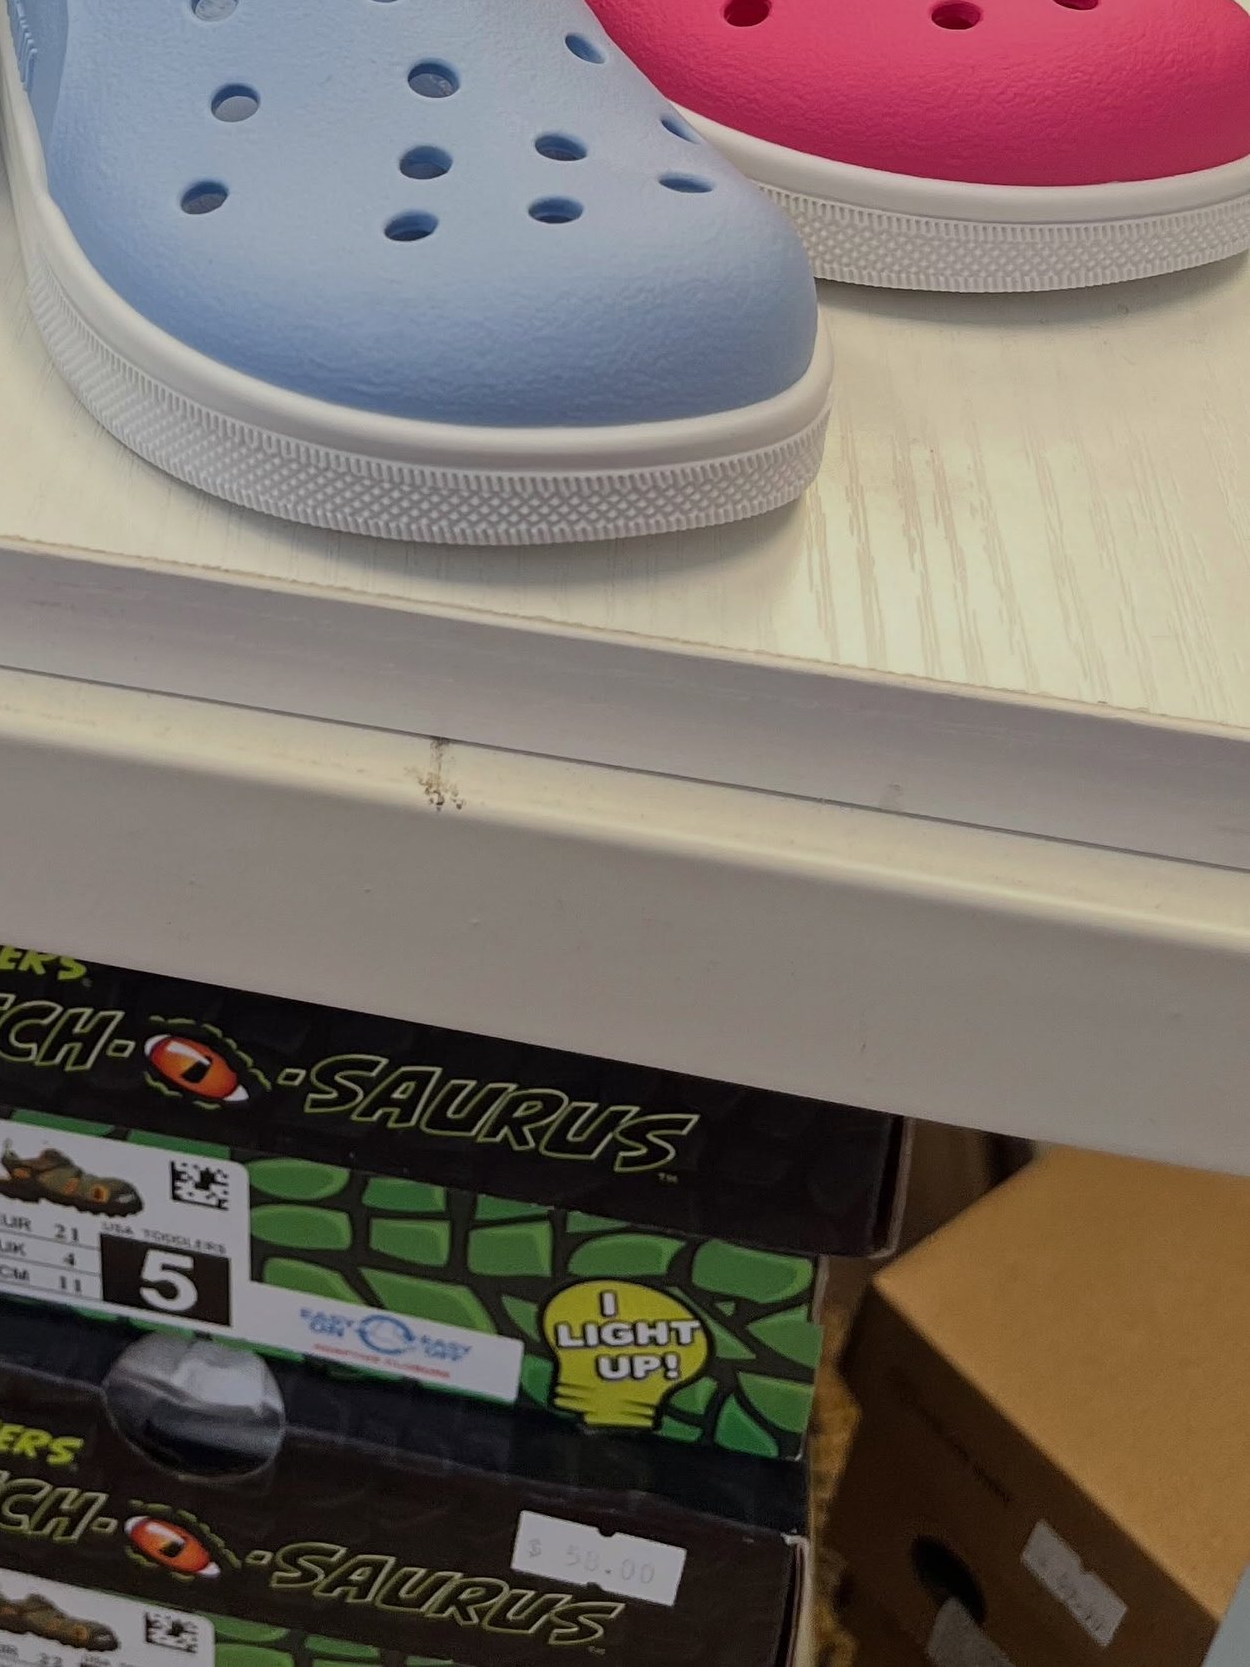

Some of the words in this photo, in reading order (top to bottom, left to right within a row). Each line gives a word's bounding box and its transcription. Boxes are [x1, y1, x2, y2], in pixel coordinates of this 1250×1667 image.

[53, 1223, 80, 1243] 21
[102, 1219, 135, 1236] USA
[64, 1252, 75, 1267] 4
[58, 1275, 83, 1293] 11
[139, 1248, 199, 1312] 5
[600, 1291, 617, 1317] I
[555, 1319, 701, 1349] LIGHT
[596, 1352, 680, 1381] UP!
